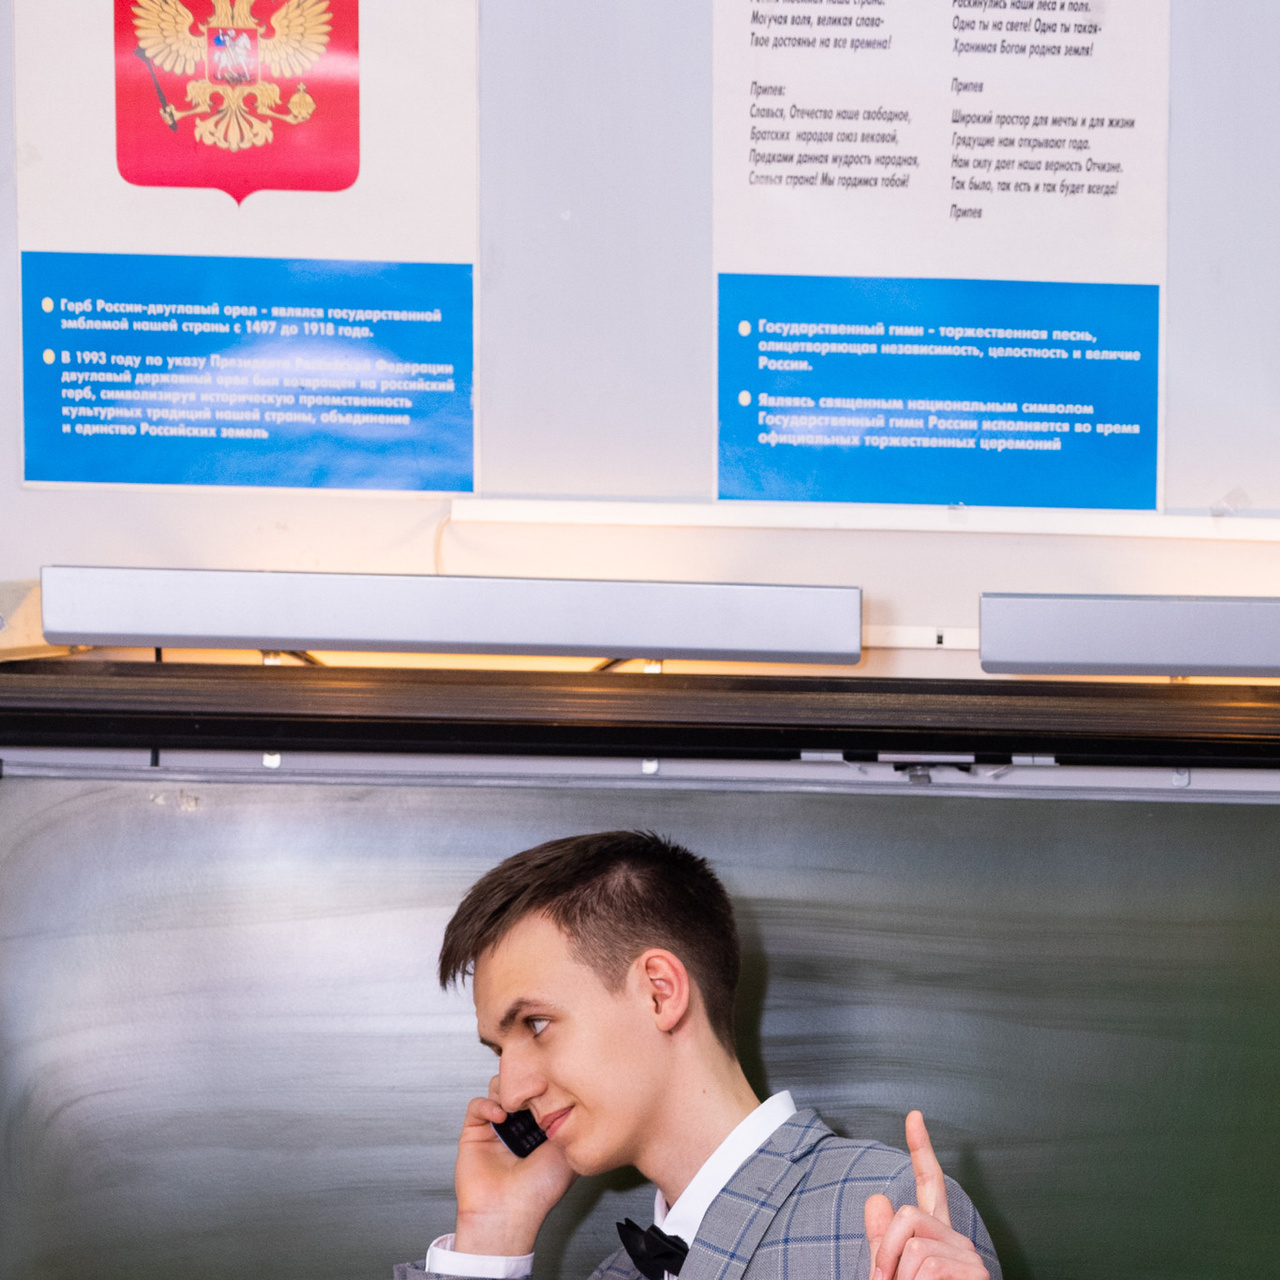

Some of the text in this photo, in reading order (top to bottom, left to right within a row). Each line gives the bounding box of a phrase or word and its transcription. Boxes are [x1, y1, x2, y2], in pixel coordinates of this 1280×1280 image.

[749, 9, 885, 28] Могучая воля, великая слава-
[750, 30, 892, 52] Твое достоянье на все времена!
[953, 37, 1094, 57] Хранимая Богом родная земля!
[750, 81, 786, 97] Припев:
[749, 102, 911, 123] Славься, Отечество наше свободное,
[951, 109, 1135, 129] Широкий простор для мечты и для жизни
[60, 298, 442, 323] Герб России-двуглавый орел являлся государственной
[61, 315, 373, 338] эмблемой нашей страны с 1497 до 1918 года.
[758, 319, 1096, 342] Государственный гимн торжественная песнь,
[60, 350, 71, 363] В
[76, 350, 106, 364] 1993
[110, 355, 141, 367] году
[145, 355, 163, 365] по
[166, 355, 206, 369] указу
[759, 340, 1140, 360] олицетворяющая независимость, целостность и величие
[758, 355, 813, 371] России.
[759, 392, 1093, 414] Являясь священным национальным символом
[62, 421, 268, 438] и единство Российских земель
[758, 411, 1140, 436] Государственный гимн России исполняется во время
[758, 431, 1061, 452] официальных торжественных церемоний
